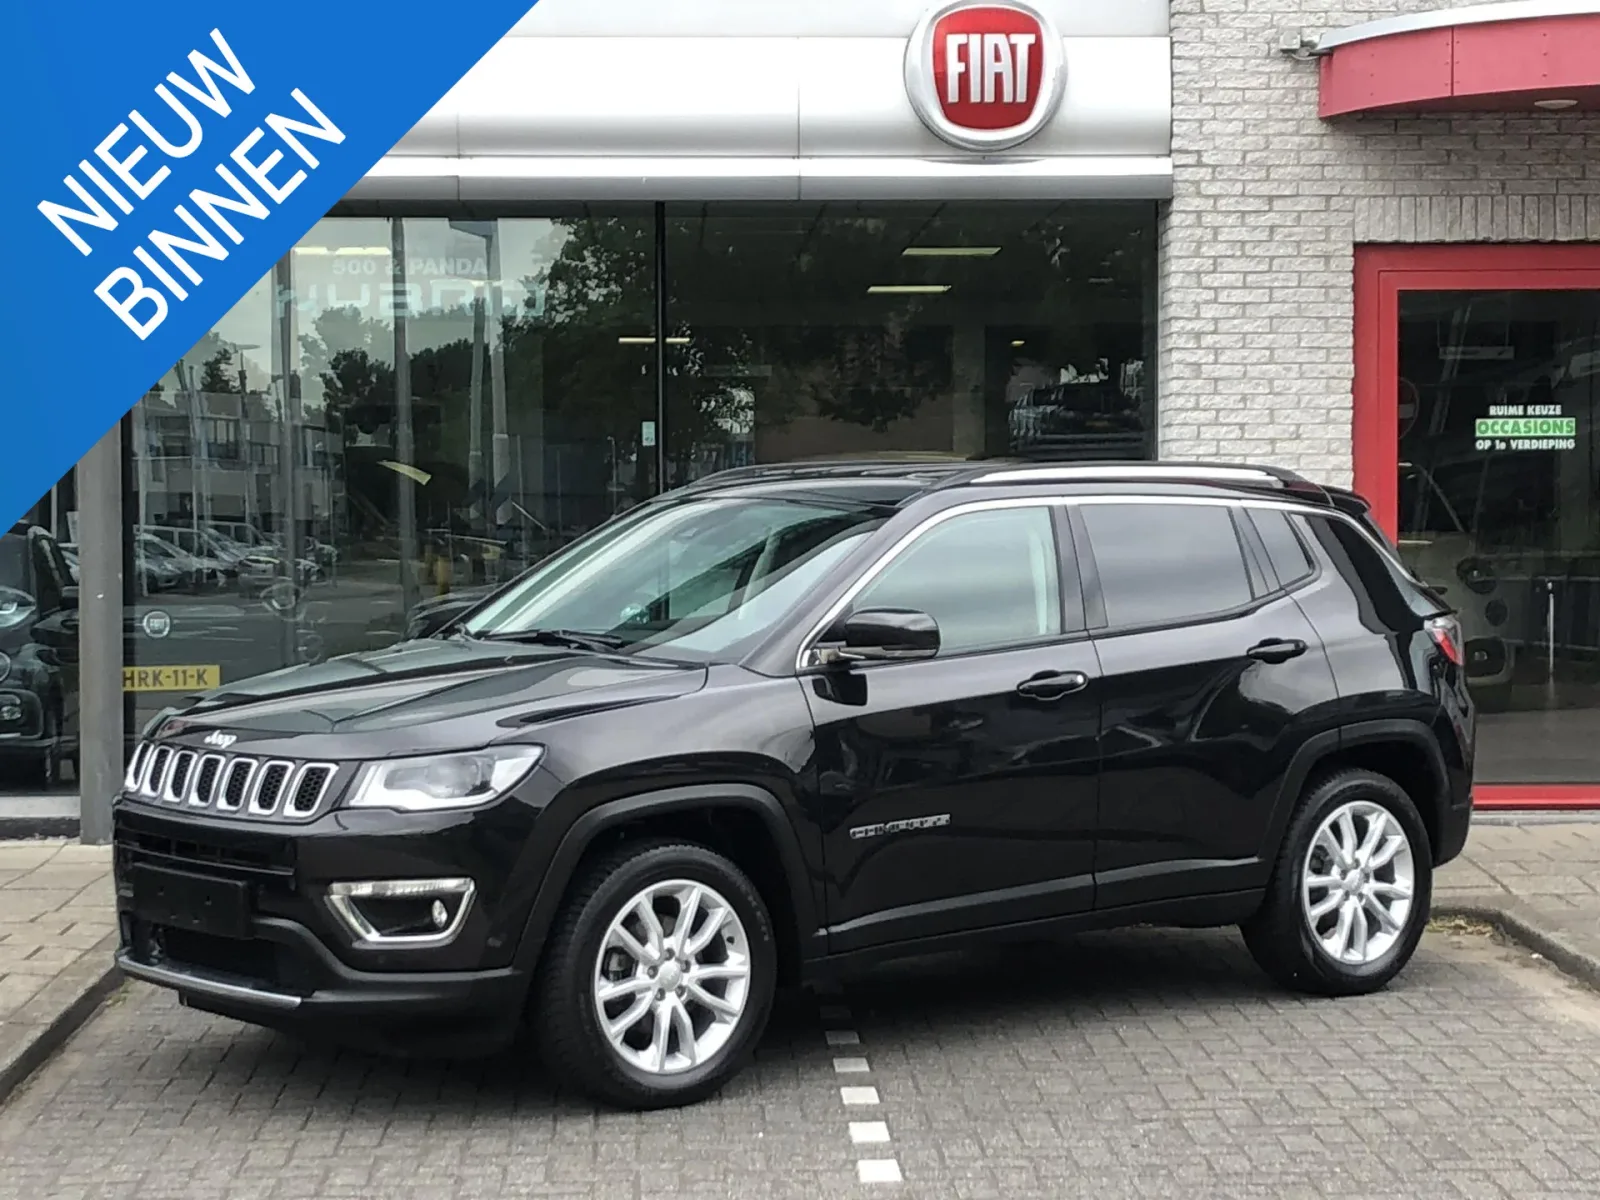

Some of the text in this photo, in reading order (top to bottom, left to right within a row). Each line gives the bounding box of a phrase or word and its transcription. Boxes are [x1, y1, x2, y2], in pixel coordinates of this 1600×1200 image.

[946, 33, 1036, 103] FIAT
[332, 258, 376, 275] 500
[407, 257, 488, 275] PANDA
[1489, 405, 1562, 416] RUIME KEUZE
[1477, 420, 1574, 435] OCCASIONS
[1475, 440, 1492, 450] OP
[1510, 439, 1575, 450] VERDIEPING
[123, 668, 208, 688] HRK-11-K
